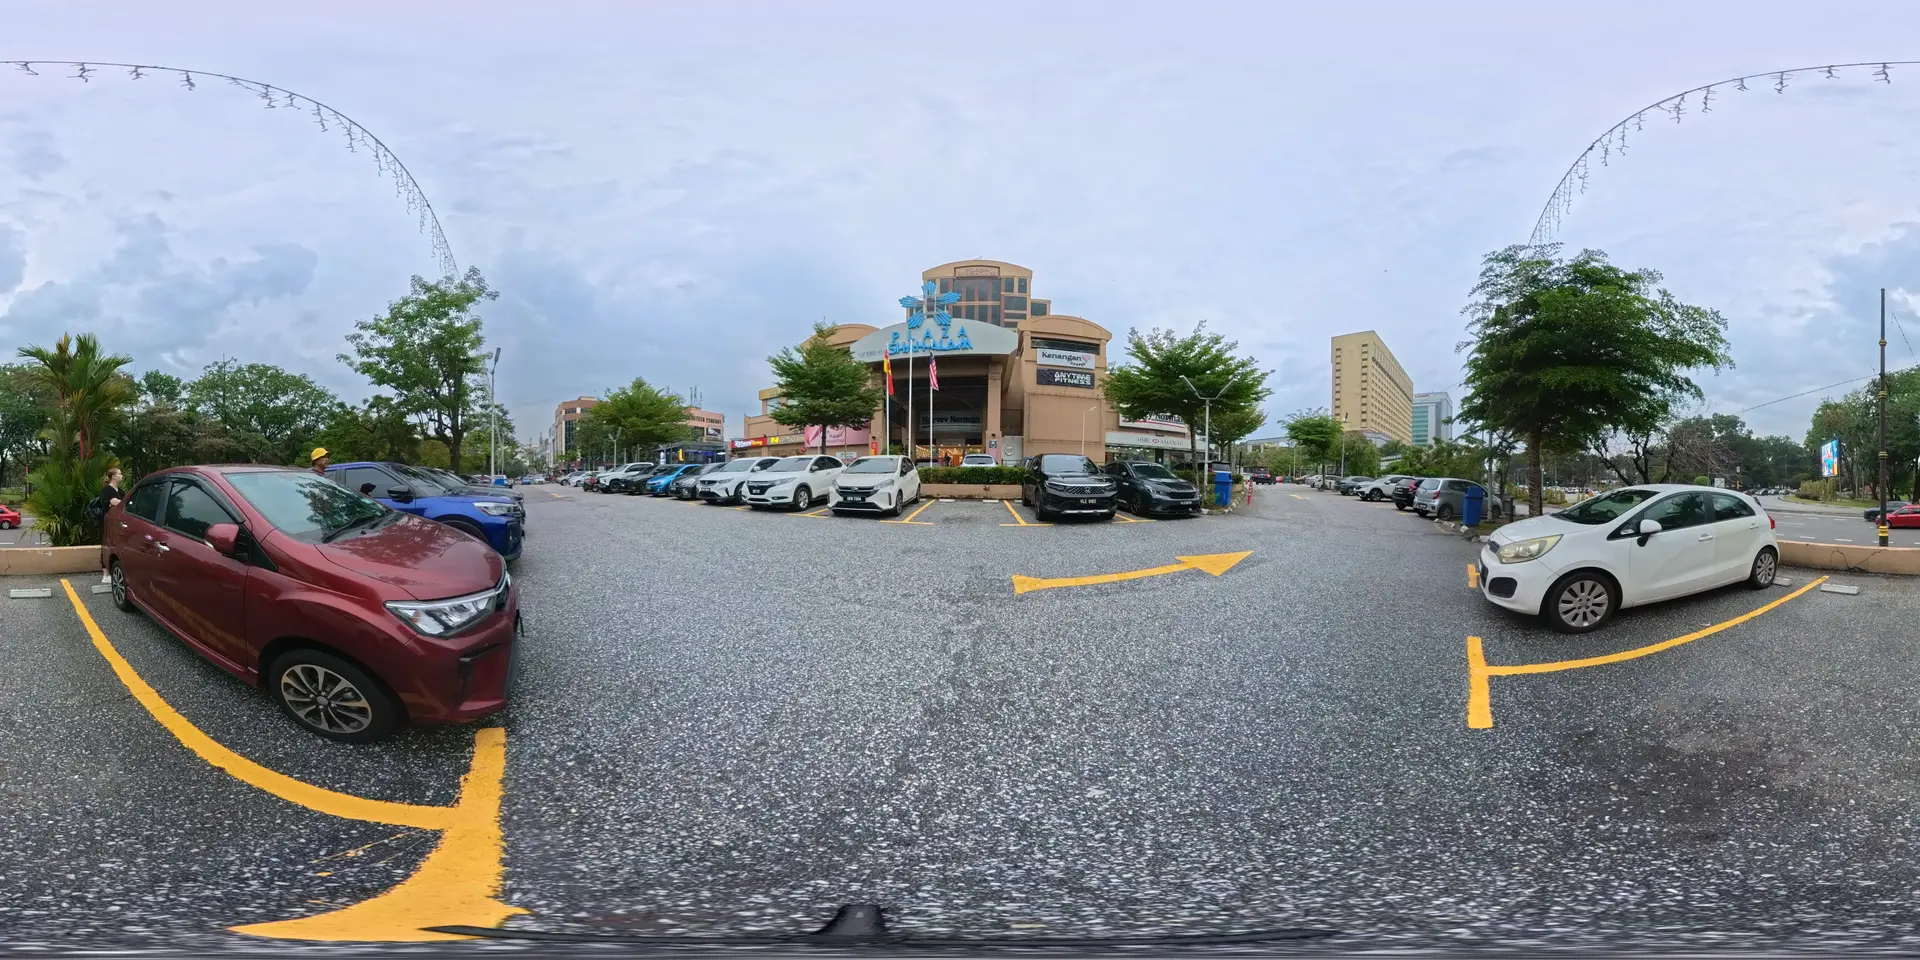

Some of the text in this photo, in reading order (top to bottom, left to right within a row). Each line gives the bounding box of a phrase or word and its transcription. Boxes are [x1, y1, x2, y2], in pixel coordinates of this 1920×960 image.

[891, 325, 968, 343] PLAZA
[1041, 351, 1082, 361] Kenangan
[1054, 371, 1091, 381] ANYTIME
[1054, 377, 1091, 386] FITNESS
[921, 416, 980, 425] Hrvey Norman
